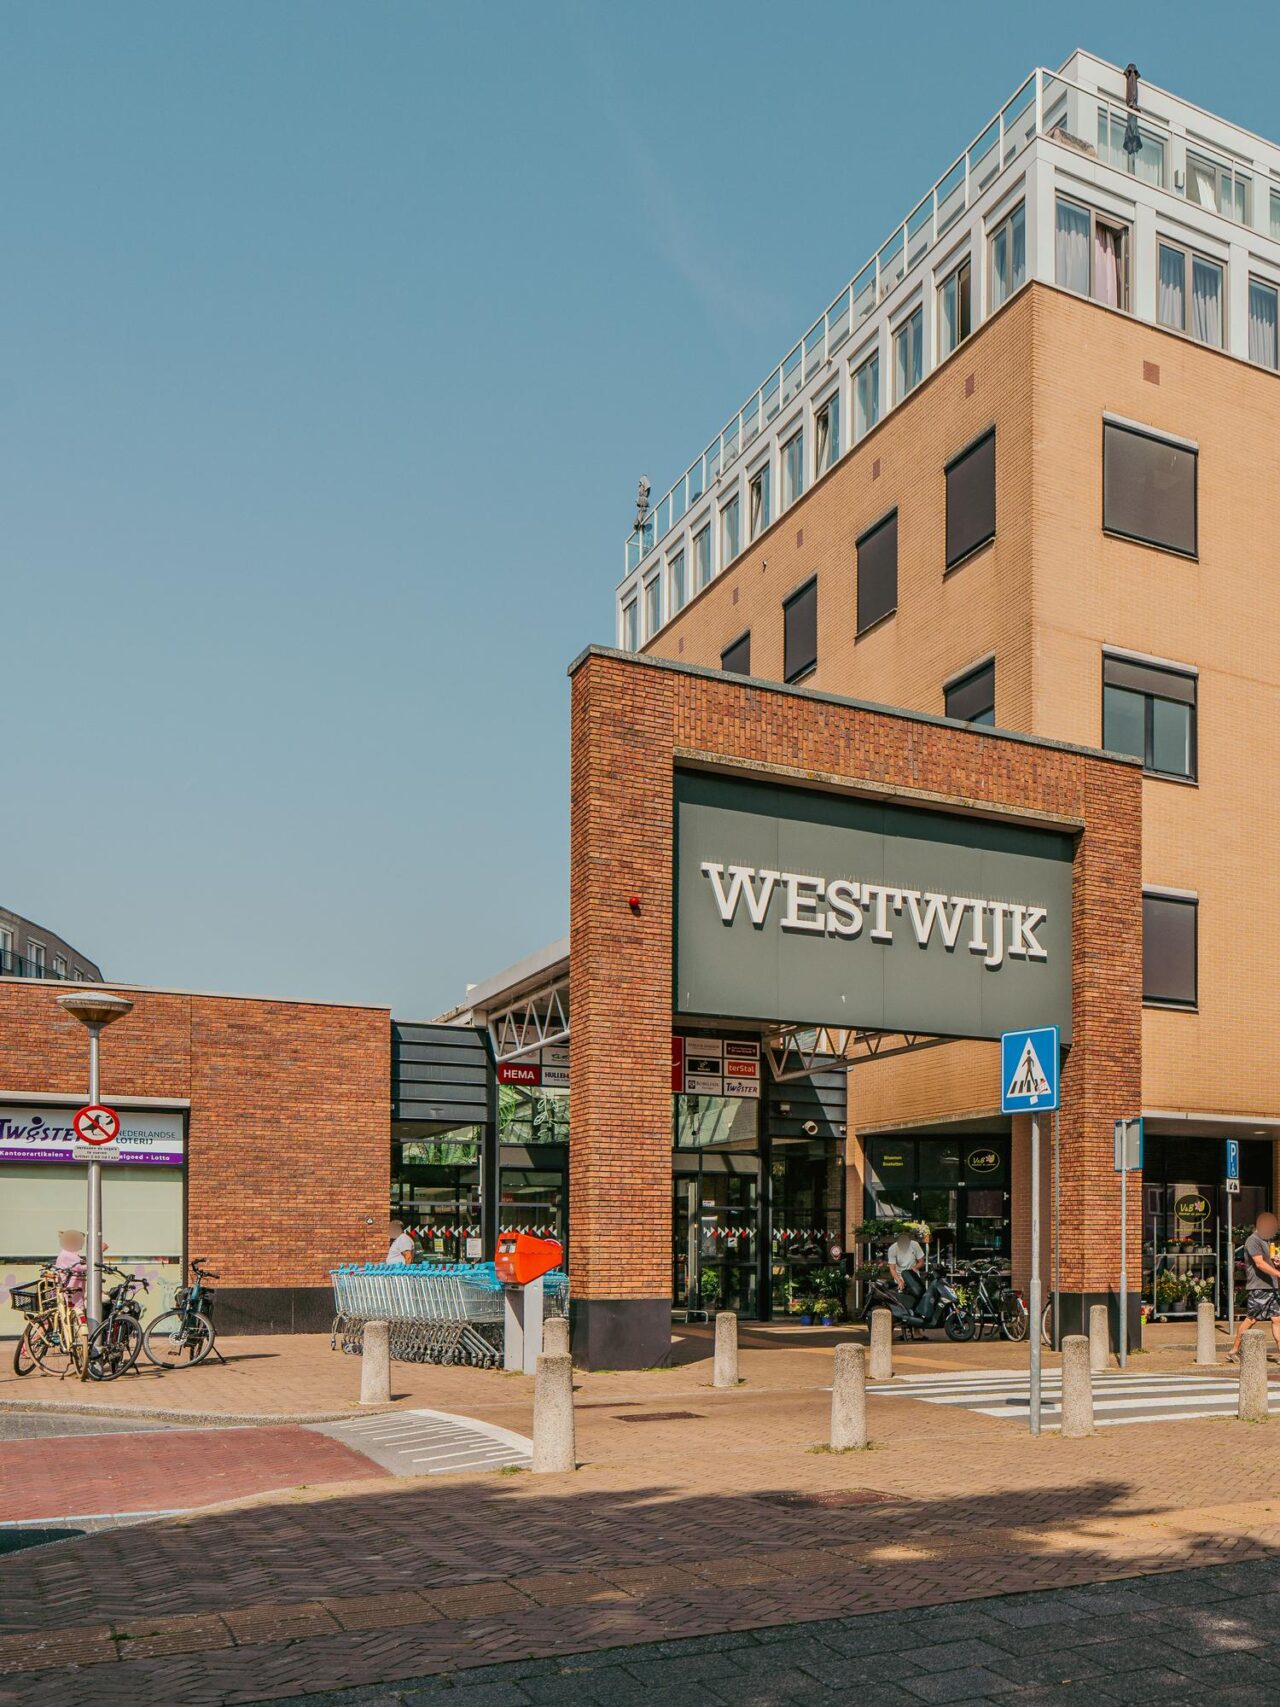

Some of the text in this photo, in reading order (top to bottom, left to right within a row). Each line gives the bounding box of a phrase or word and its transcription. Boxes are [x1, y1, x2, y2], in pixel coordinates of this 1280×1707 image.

[701, 862, 1047, 967] WESTWIJK
[503, 1069, 535, 1079] HEMA
[728, 1065, 754, 1073] terStal
[1230, 1143, 1237, 1163] P
